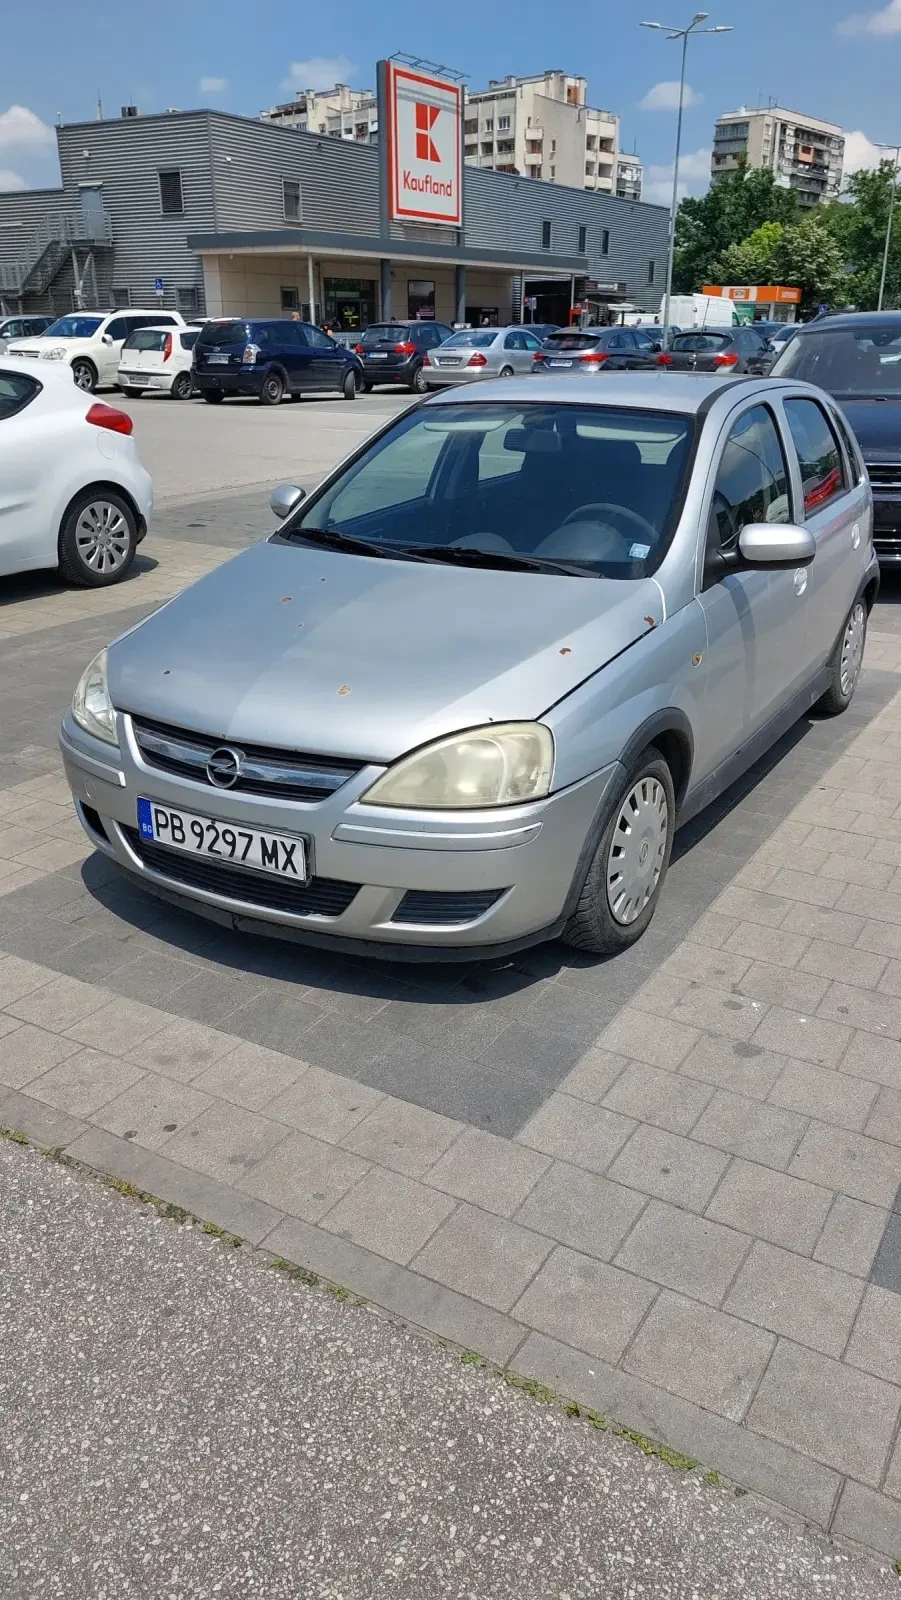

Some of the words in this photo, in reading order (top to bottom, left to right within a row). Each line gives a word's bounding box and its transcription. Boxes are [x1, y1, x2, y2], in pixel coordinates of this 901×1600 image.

[416, 102, 441, 163] K
[403, 170, 452, 197] Kaufland
[142, 823, 152, 833] BG
[154, 808, 186, 844] PB
[190, 820, 254, 861] 9297
[260, 837, 298, 874] MX
